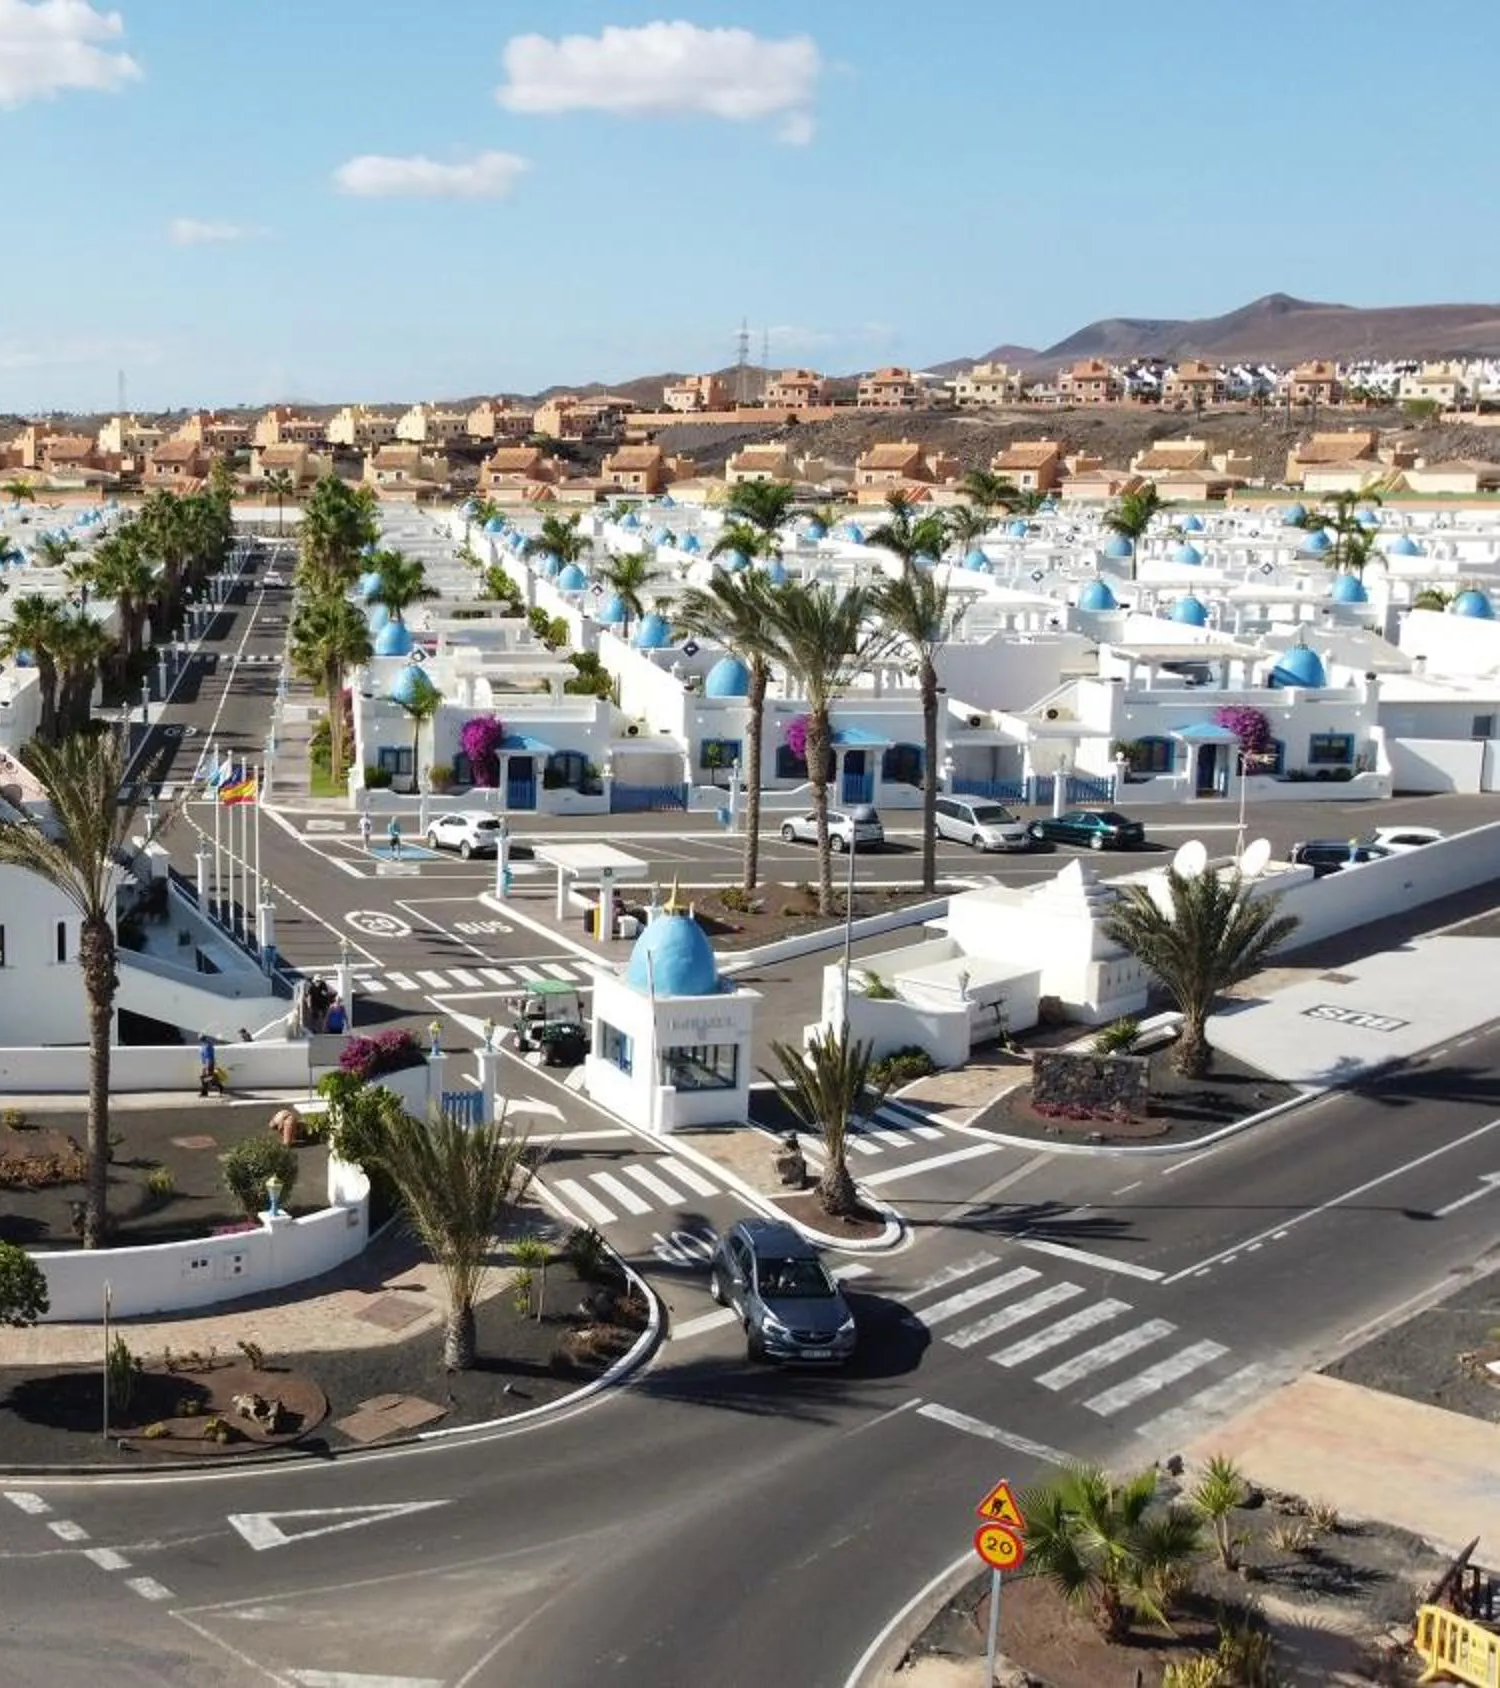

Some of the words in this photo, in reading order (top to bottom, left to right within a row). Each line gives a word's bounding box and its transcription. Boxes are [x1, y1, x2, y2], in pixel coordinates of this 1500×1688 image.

[360, 918, 397, 931] 20
[453, 920, 515, 935] BUS
[986, 1536, 1013, 1555] 20
